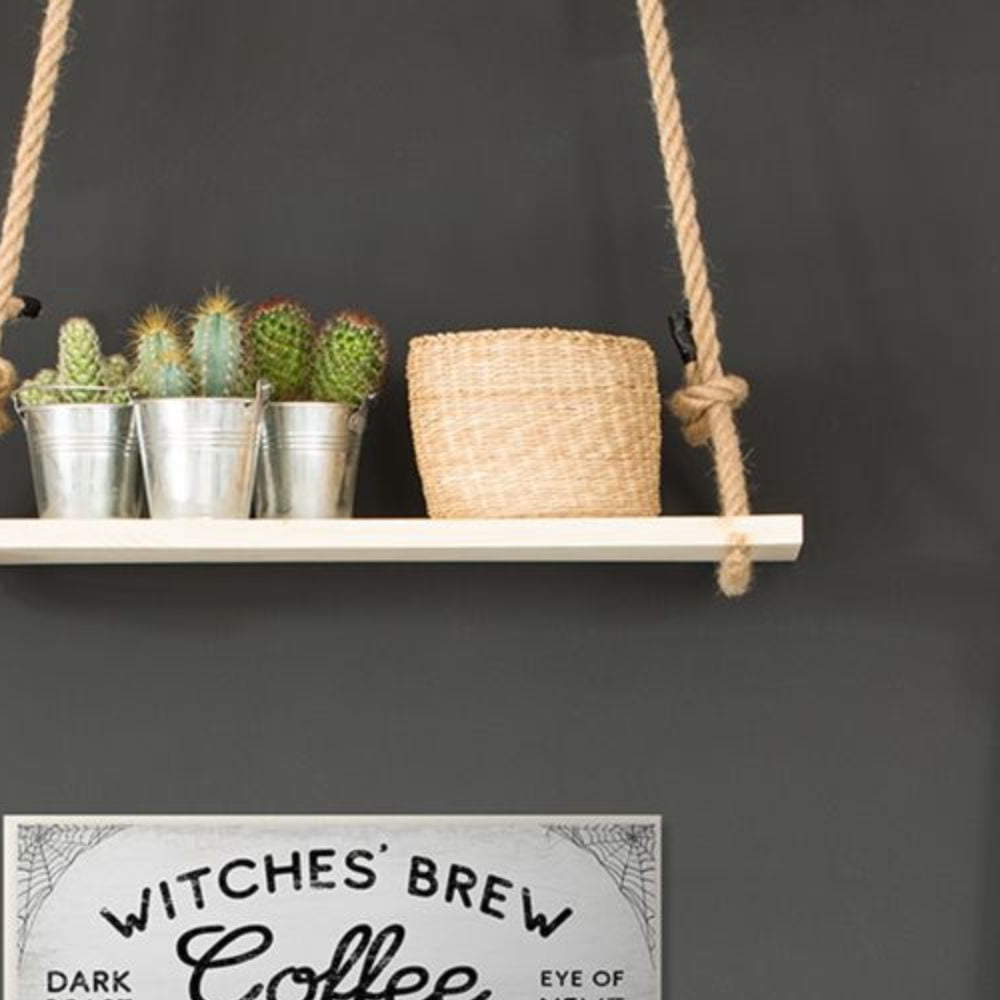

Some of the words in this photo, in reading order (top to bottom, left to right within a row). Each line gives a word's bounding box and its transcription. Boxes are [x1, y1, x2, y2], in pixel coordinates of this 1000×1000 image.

[100, 843, 388, 938] WITCHES'
[407, 855, 573, 938] BREW
[46, 970, 132, 993] DARK
[540, 969, 583, 988] EYE
[591, 969, 625, 988] OF
